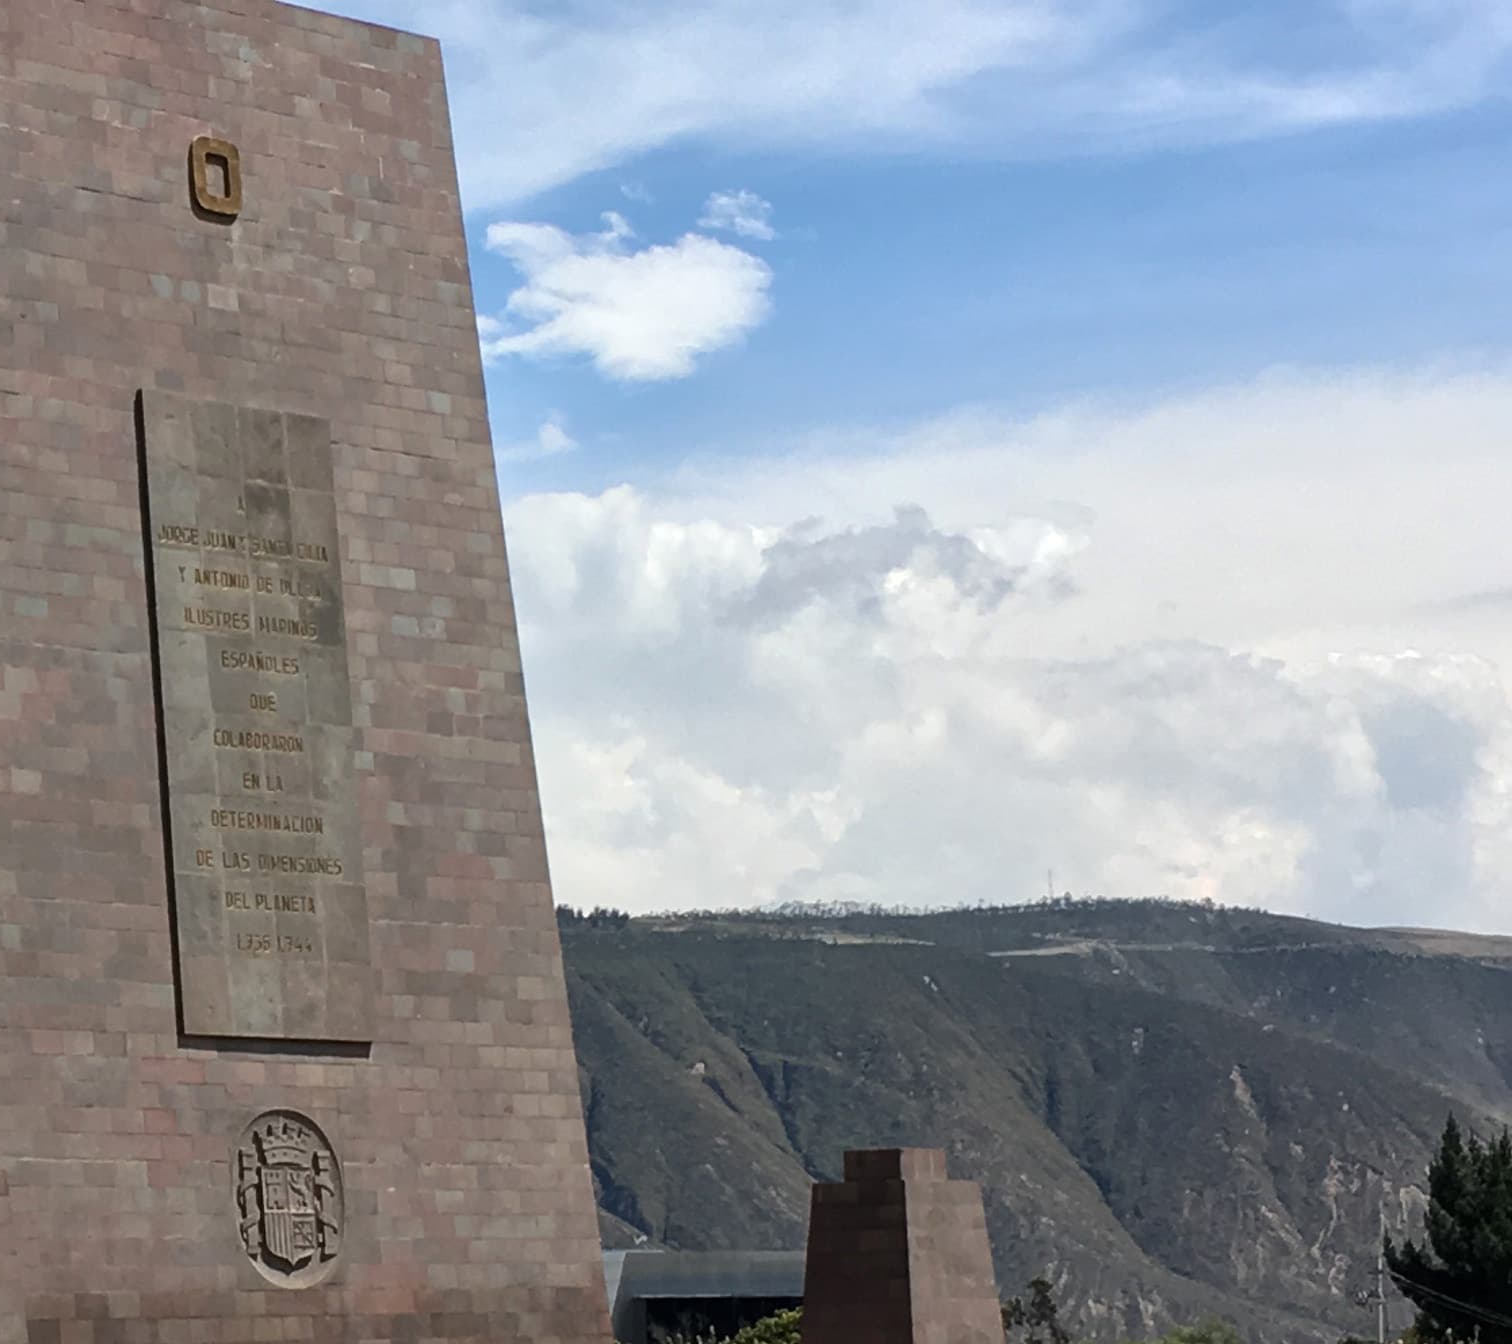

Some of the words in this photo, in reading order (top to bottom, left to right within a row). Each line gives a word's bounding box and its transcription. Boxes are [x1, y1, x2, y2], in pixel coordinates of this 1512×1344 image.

[190, 135, 243, 222] O
[158, 524, 199, 545] JORGE
[203, 529, 236, 550] JUAN
[178, 566, 186, 582] Y
[194, 568, 250, 590] ANTONIO
[256, 576, 272, 594] DE
[184, 607, 250, 630] ILUSTRES
[258, 616, 318, 638] MARINOS
[221, 649, 299, 673] ESPAÑOLES
[249, 693, 277, 712] QUE
[213, 729, 303, 753] COLABORARON
[243, 772, 260, 791] EN
[267, 774, 283, 792] LA
[211, 809, 324, 834] DETERMINACION
[196, 849, 213, 867] DE
[223, 851, 250, 870] LAS
[258, 854, 342, 875] DIMENSIONES
[225, 892, 250, 910] DEL
[256, 894, 316, 914] PLANETA
